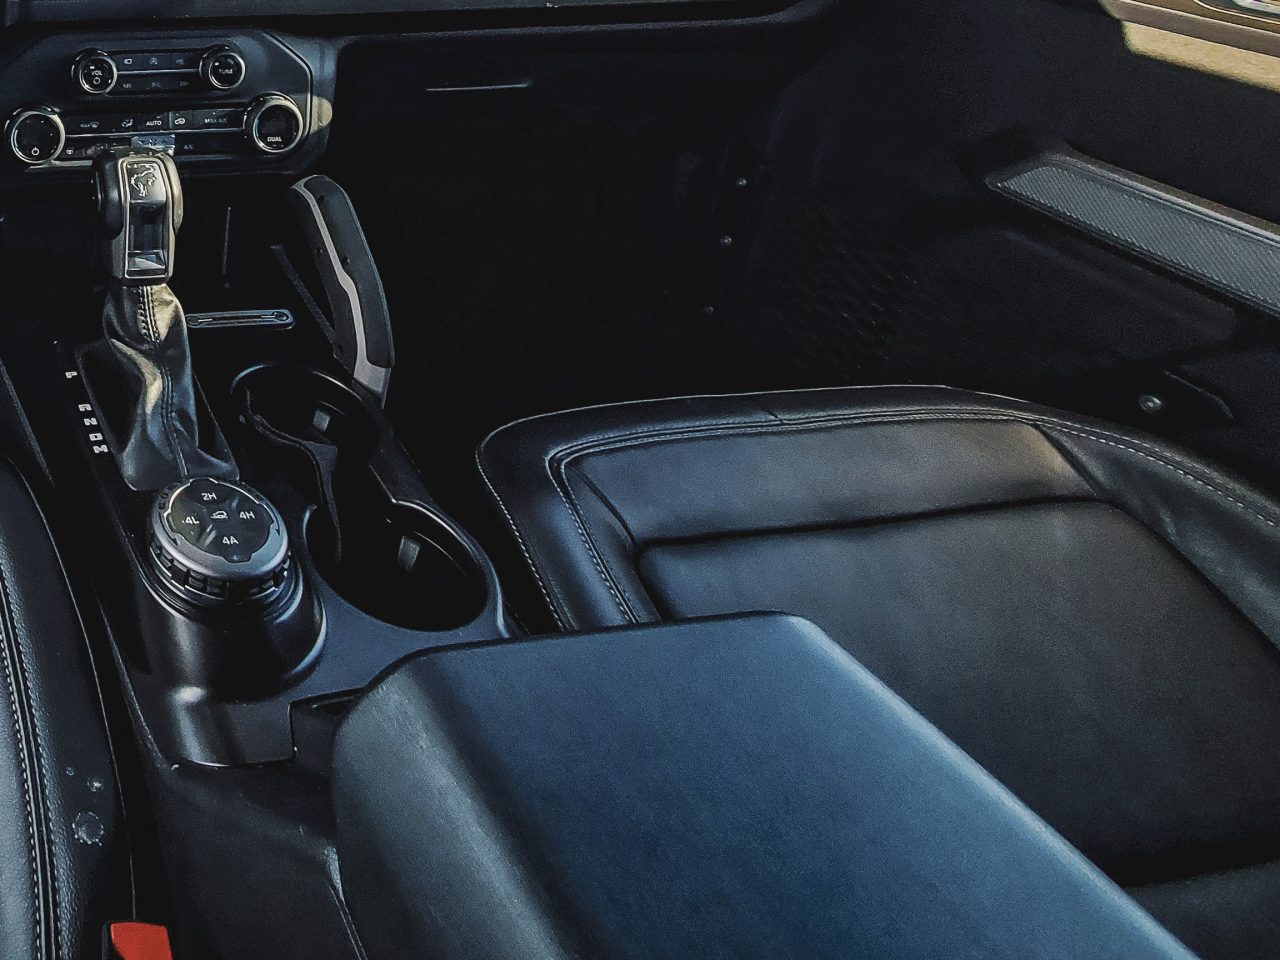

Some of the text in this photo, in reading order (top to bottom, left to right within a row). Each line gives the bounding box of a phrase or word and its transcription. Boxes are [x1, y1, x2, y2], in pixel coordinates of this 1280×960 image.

[65, 371, 78, 379] P
[78, 403, 92, 411] R
[84, 417, 98, 426] N
[93, 444, 108, 454] M
[201, 492, 217, 501] 2H
[239, 511, 255, 519] 4H
[185, 516, 200, 525] 4L
[222, 535, 239, 545] 4A
